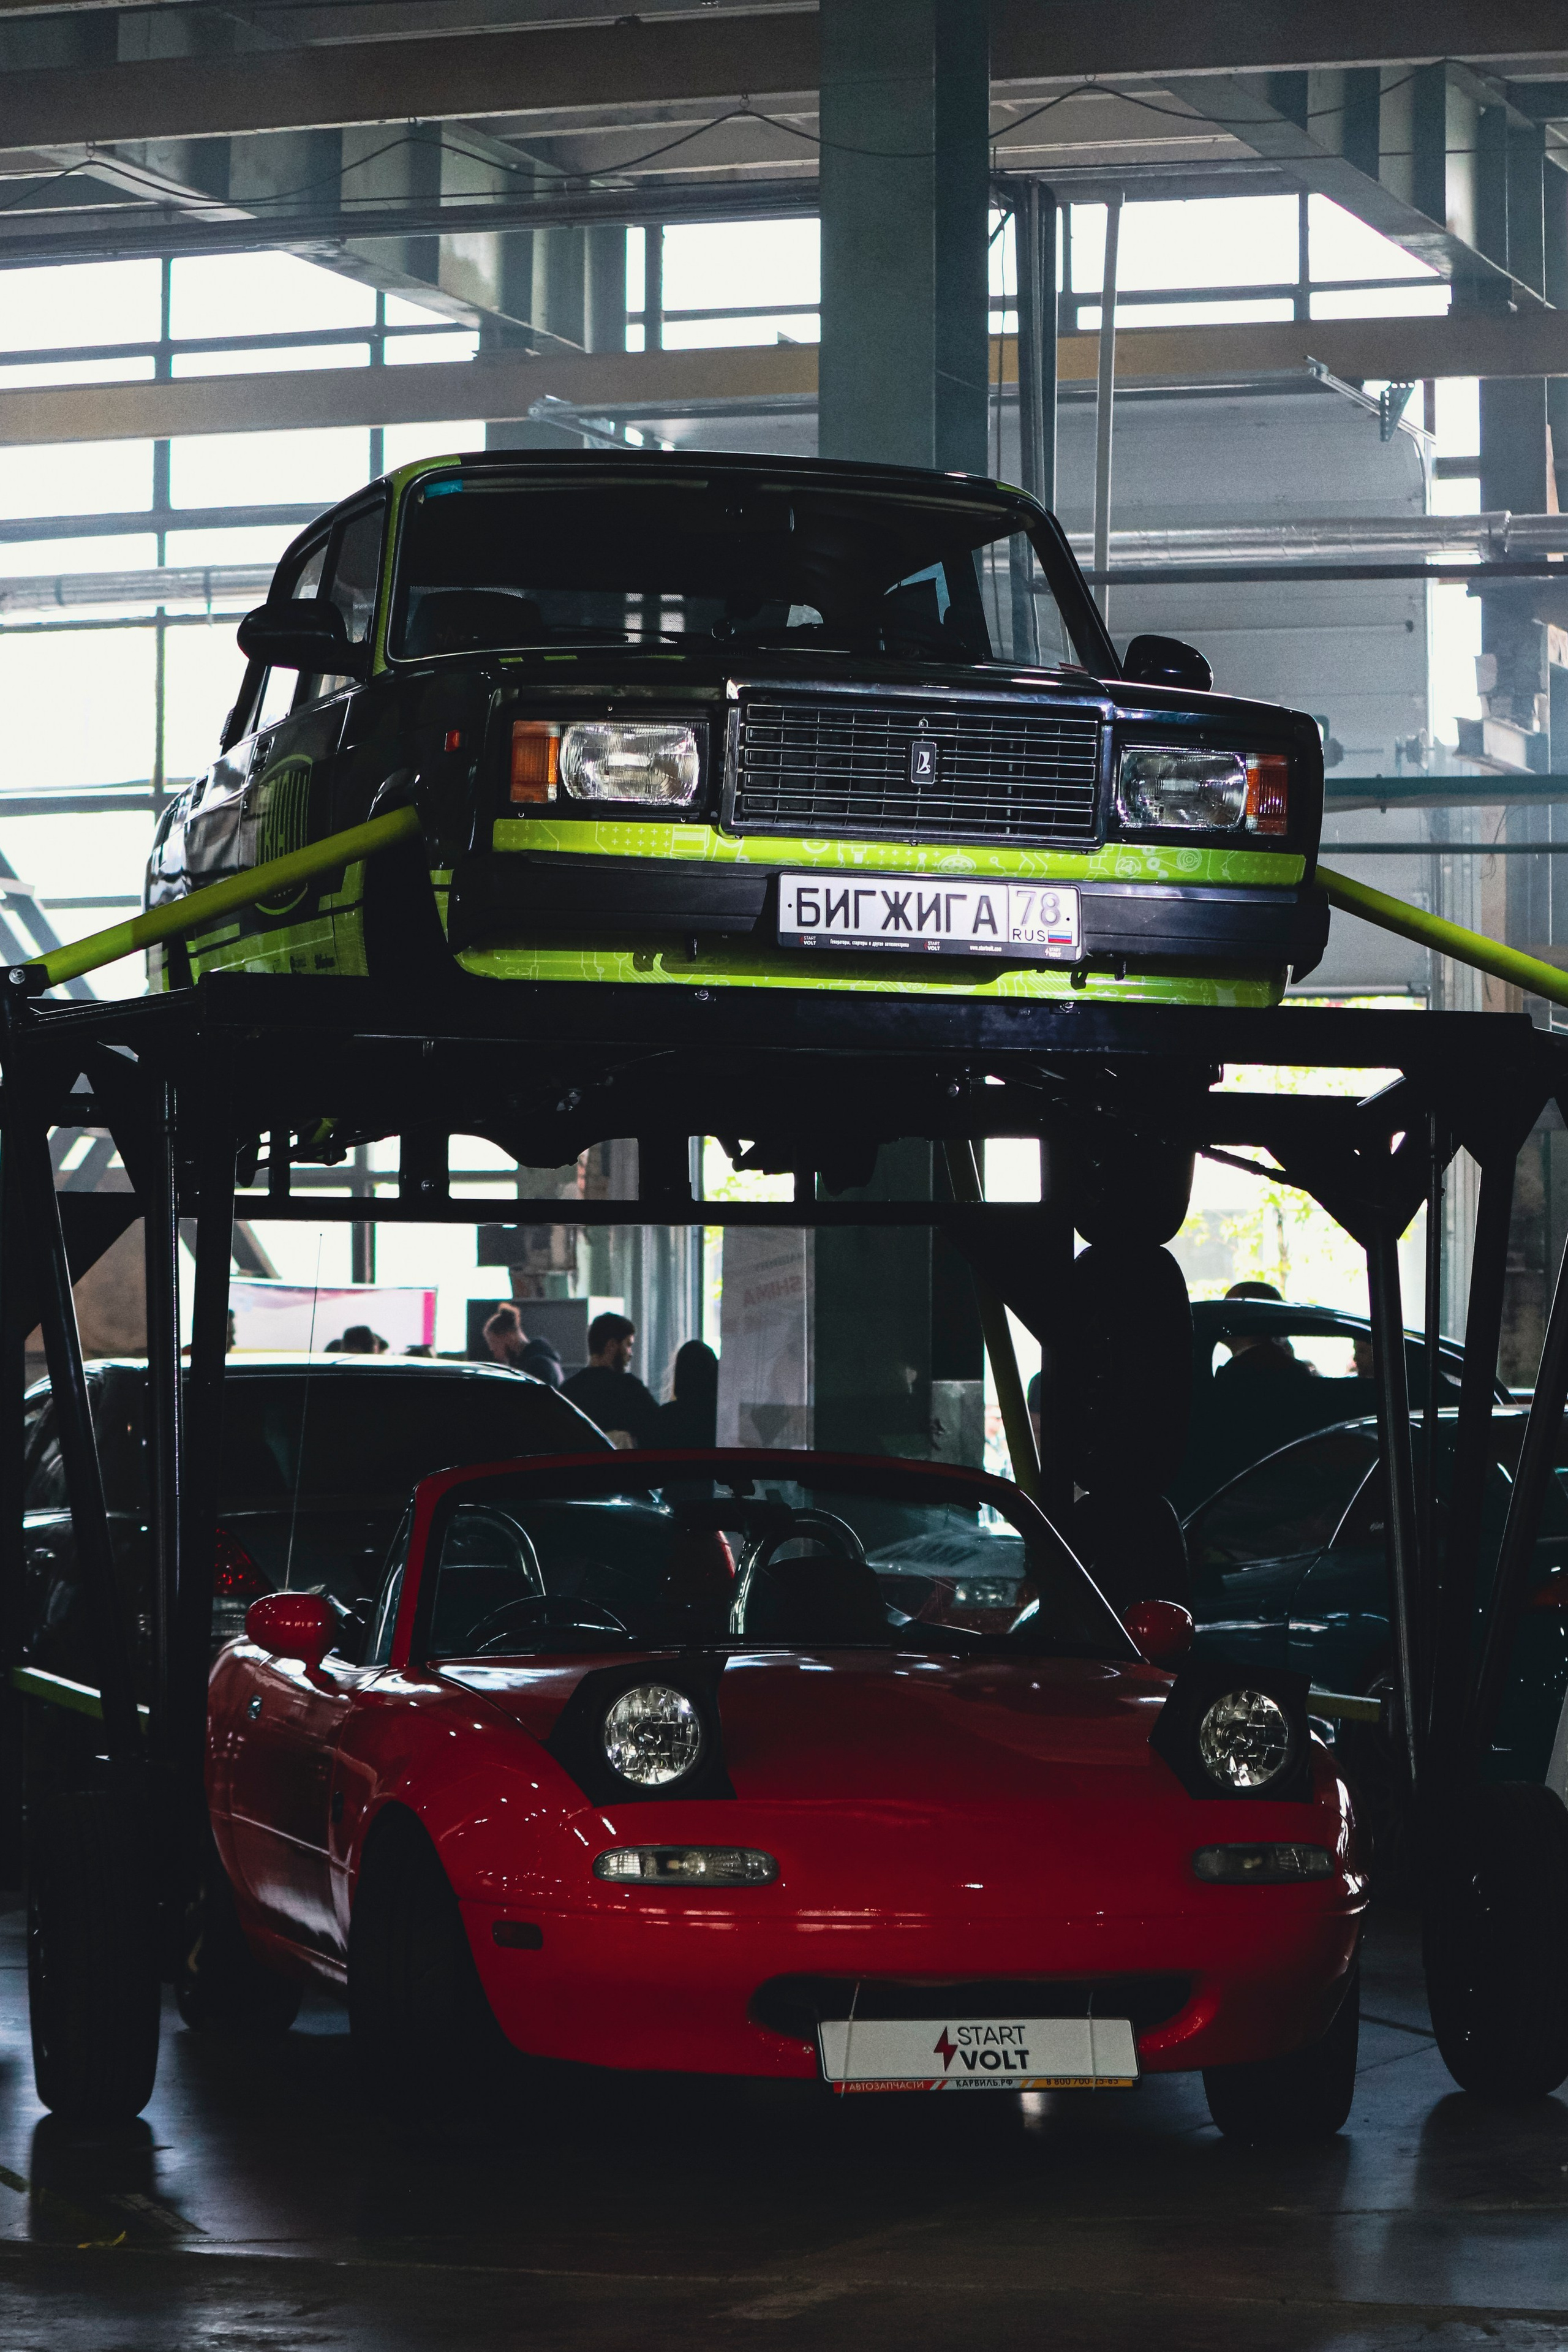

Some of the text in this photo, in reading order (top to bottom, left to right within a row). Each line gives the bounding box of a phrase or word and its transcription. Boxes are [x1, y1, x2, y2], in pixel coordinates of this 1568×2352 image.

[796, 887, 998, 935] БИГЖИГА
[1016, 890, 1061, 926] 78
[1012, 928, 1046, 943] RUS
[957, 2026, 1026, 2046] START
[960, 2050, 1030, 2070] VOLT
[848, 2081, 924, 2091] АВТОЗАПЧАСТИ
[956, 2079, 1013, 2087] КАРВИЛЬ.РФ
